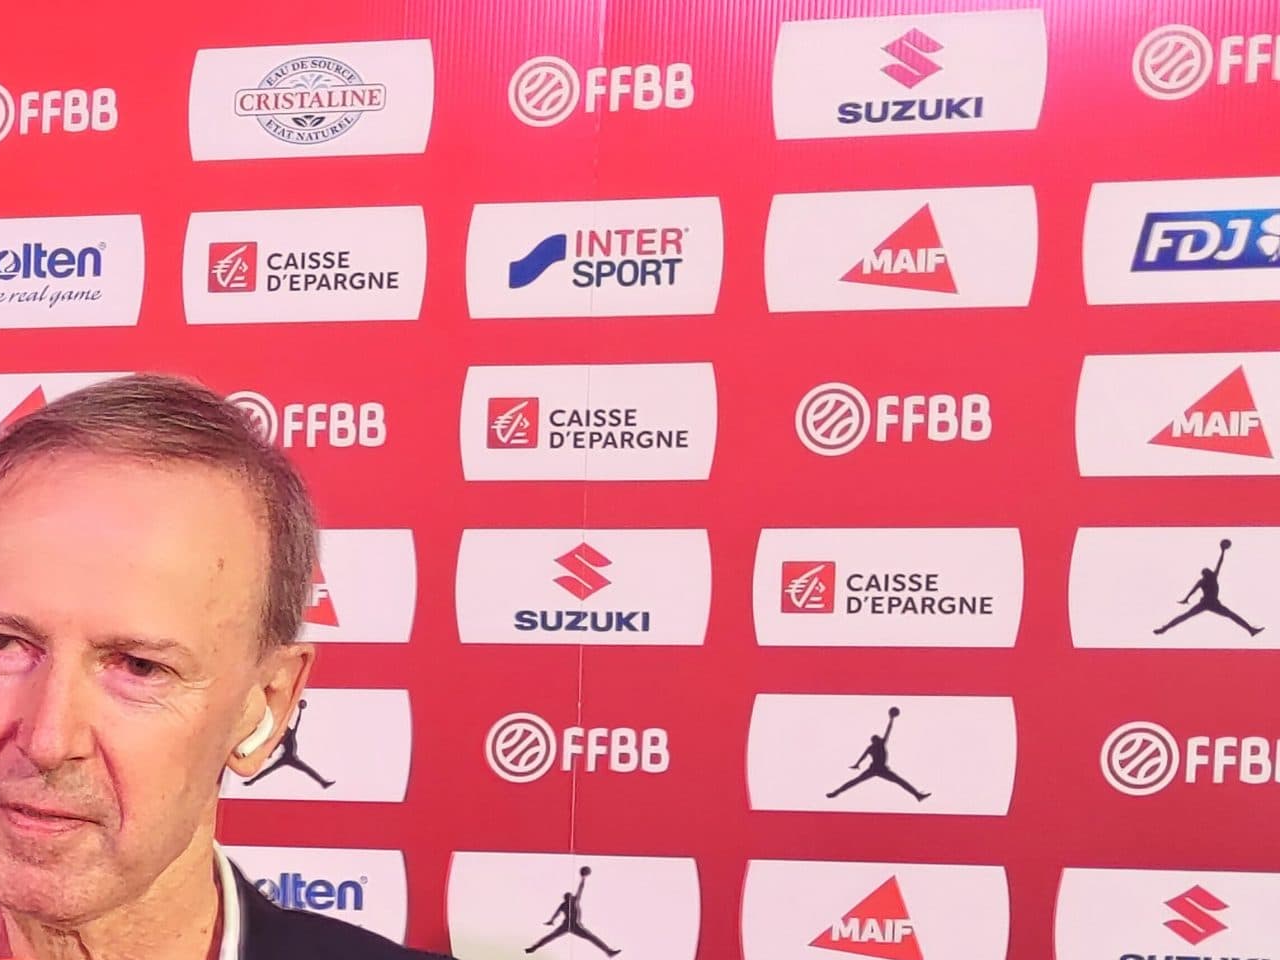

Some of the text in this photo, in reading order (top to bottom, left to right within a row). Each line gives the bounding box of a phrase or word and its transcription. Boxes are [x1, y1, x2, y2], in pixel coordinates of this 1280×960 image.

[266, 59, 356, 86] EAU DE SOURCE
[1217, 34, 1280, 85] FF
[239, 88, 382, 112] CRISTALINE
[585, 64, 695, 112] FFBB
[19, 88, 118, 137] FFBB
[837, 97, 983, 125] SUZUKI
[265, 116, 355, 141] ETAT NATUREL
[574, 228, 683, 258] INTER
[1144, 219, 1252, 262] FDJ
[267, 250, 351, 271] CAISSE
[572, 259, 684, 289] SPORT
[862, 248, 947, 275] MAIF
[267, 269, 400, 293] D'EPARGNE
[9, 284, 50, 303] real
[48, 289, 102, 308] game
[283, 402, 387, 449] FFBB
[548, 408, 638, 429] CAISSE
[875, 394, 993, 442] FFBB
[1171, 411, 1261, 438] MAIF
[548, 429, 690, 450] D'EPARGNE
[846, 573, 939, 594] CAISSE
[846, 594, 994, 616] D'EPARGNE
[513, 610, 651, 633] SUZUKI
[561, 727, 670, 774] FFBB
[1185, 736, 1280, 784] FFB
[831, 917, 915, 943] MAIF
